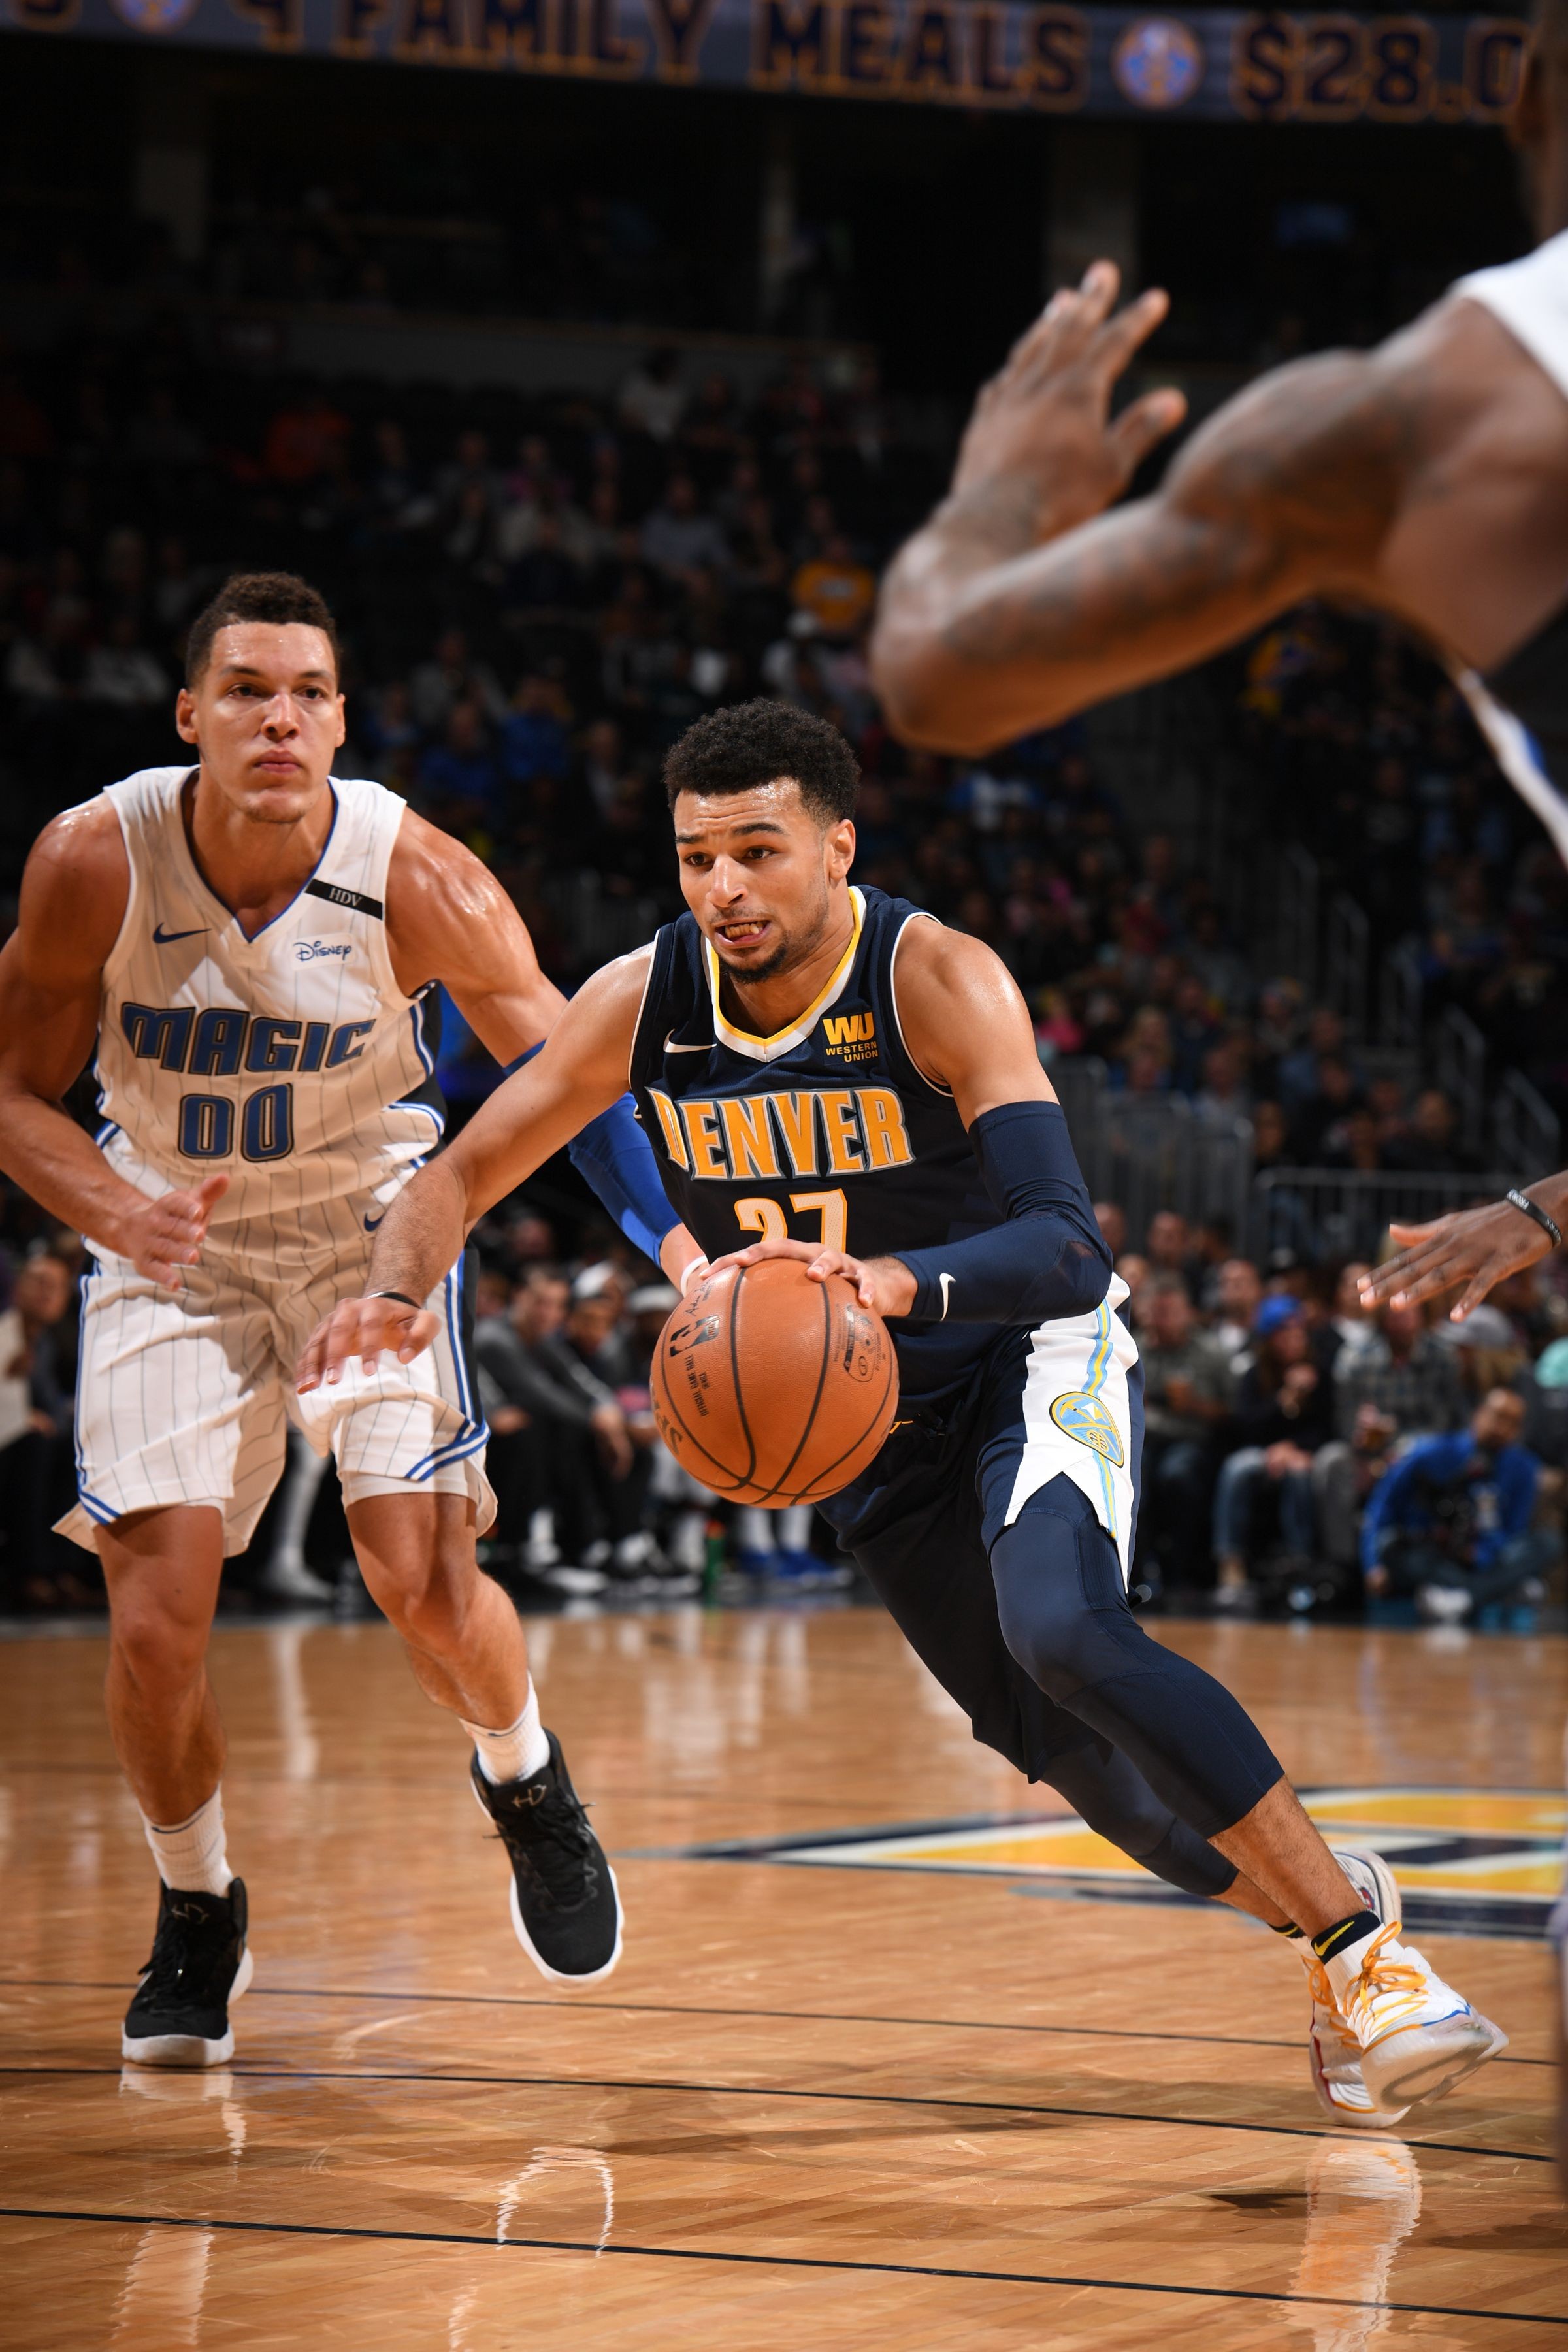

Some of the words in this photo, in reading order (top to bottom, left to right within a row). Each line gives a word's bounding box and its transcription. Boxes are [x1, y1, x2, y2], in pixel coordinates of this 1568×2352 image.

[329, 0, 717, 88] FAMILY
[745, 0, 1090, 114] MEALS
[329, 887, 362, 907] HDV
[293, 941, 351, 962] Disney
[121, 1002, 376, 1076] MAGIC
[823, 1012, 874, 1045] WU
[826, 1041, 877, 1056] WESTERN
[843, 1049, 879, 1062] UNION
[178, 1082, 295, 1163] 00
[645, 1086, 916, 1181] DENVER
[684, 1353, 694, 1371] BALL
[688, 1371, 698, 1390] GAME
[693, 1390, 710, 1417] OFFICIAL
